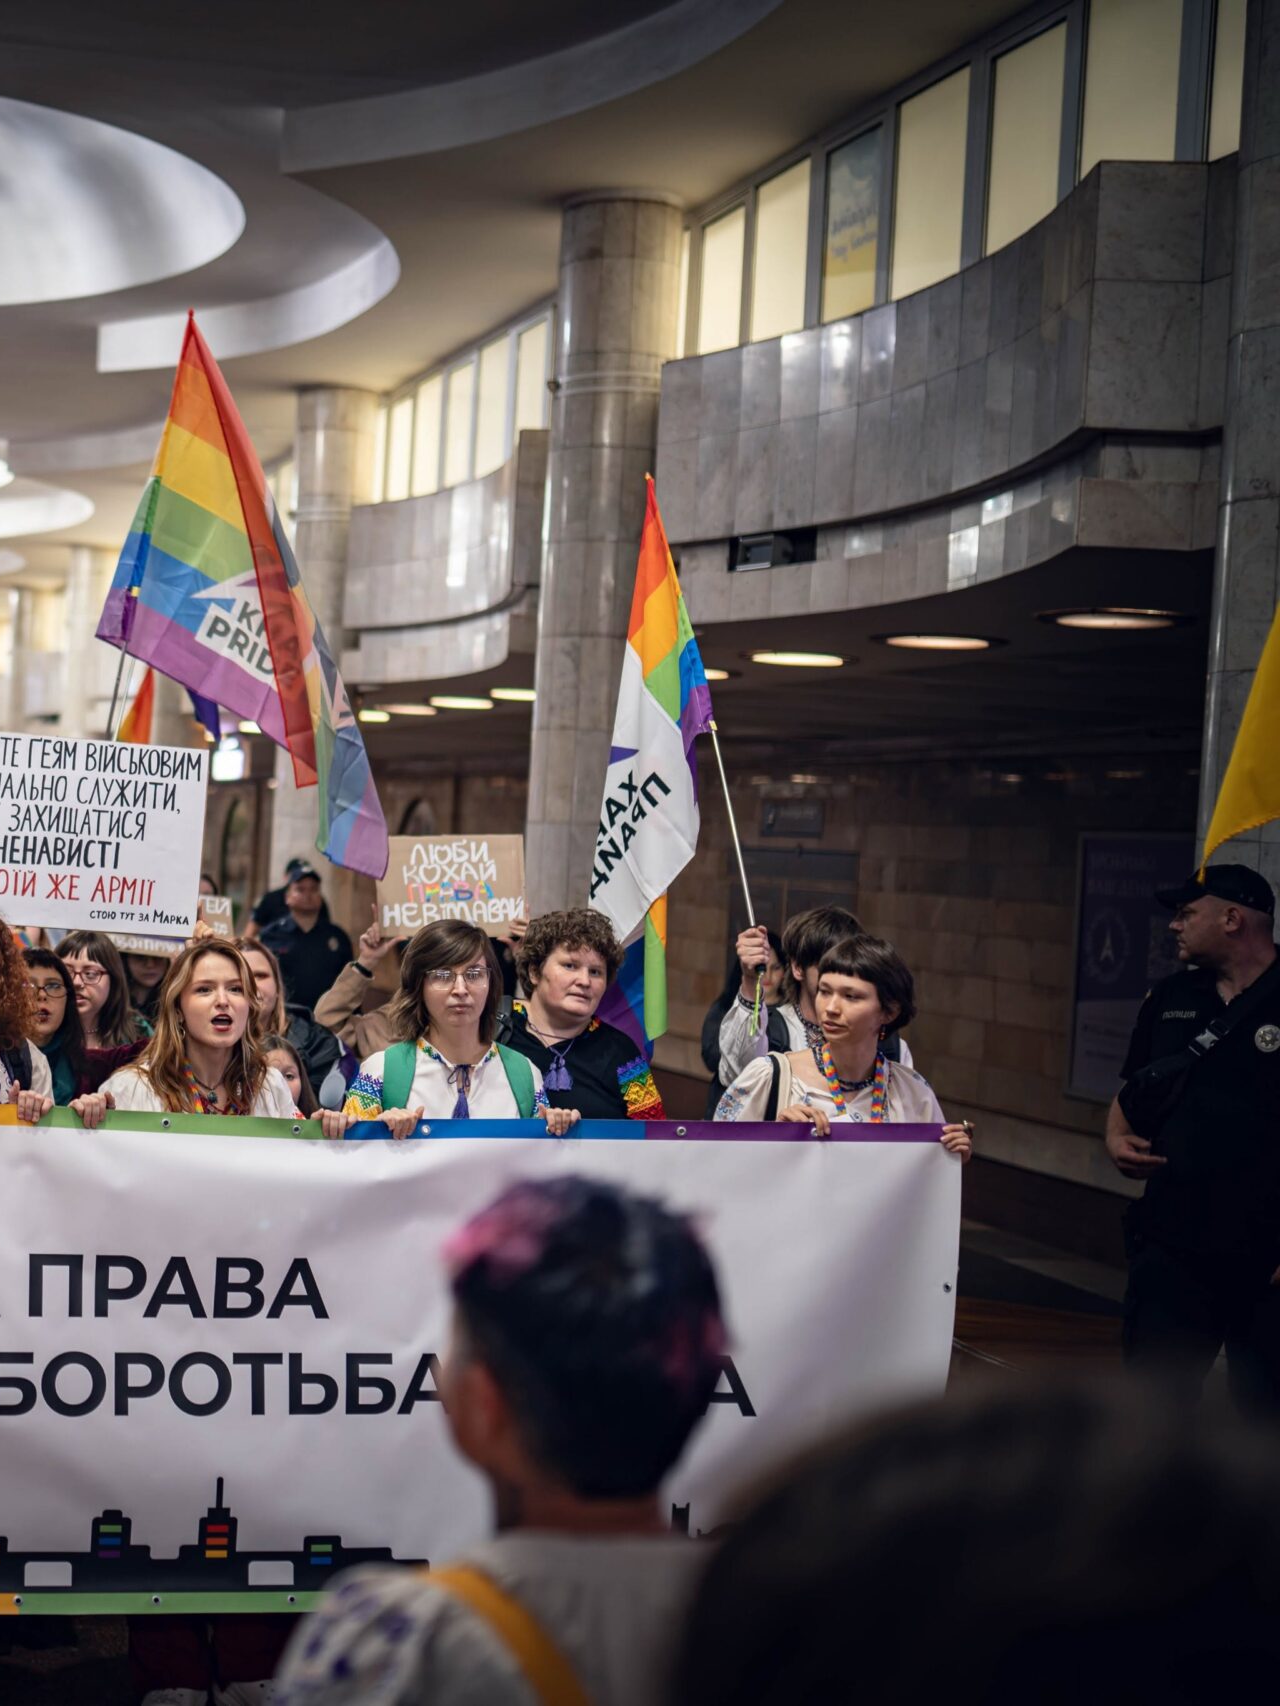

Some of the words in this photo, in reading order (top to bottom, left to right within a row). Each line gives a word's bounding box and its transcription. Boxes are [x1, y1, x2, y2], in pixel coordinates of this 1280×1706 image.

[206, 615, 277, 676] PRID
[85, 742, 202, 782] ВІЙСЬКОВИМ
[76, 776, 181, 815] СЛУЖИТИ,
[8, 803, 147, 842] ЗАХИЩАТИСЯ
[410, 838, 489, 866] ЛЮБИ
[45, 873, 81, 901] ЖЕ
[90, 875, 156, 906] АРМІЇ
[402, 859, 497, 886] КОХАЙ
[406, 880, 495, 903] ПРАВА
[28, 1253, 330, 1319] ПРАВА
